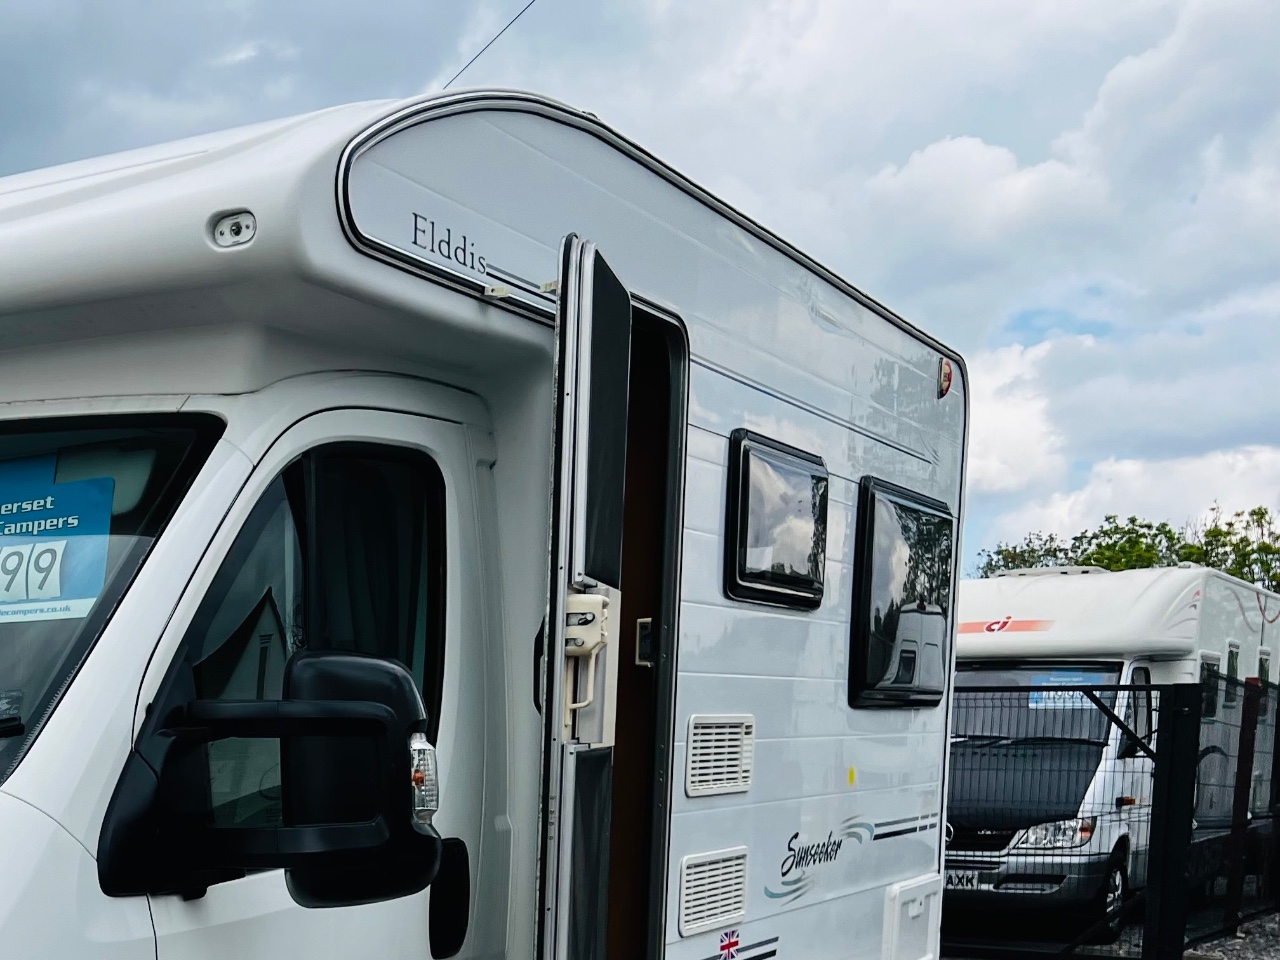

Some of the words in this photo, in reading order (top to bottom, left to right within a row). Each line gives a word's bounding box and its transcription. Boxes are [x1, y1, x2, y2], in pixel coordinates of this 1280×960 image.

[411, 212, 488, 275] Elddis
[781, 830, 843, 878] Sunseeker
[946, 874, 974, 888] AXK
